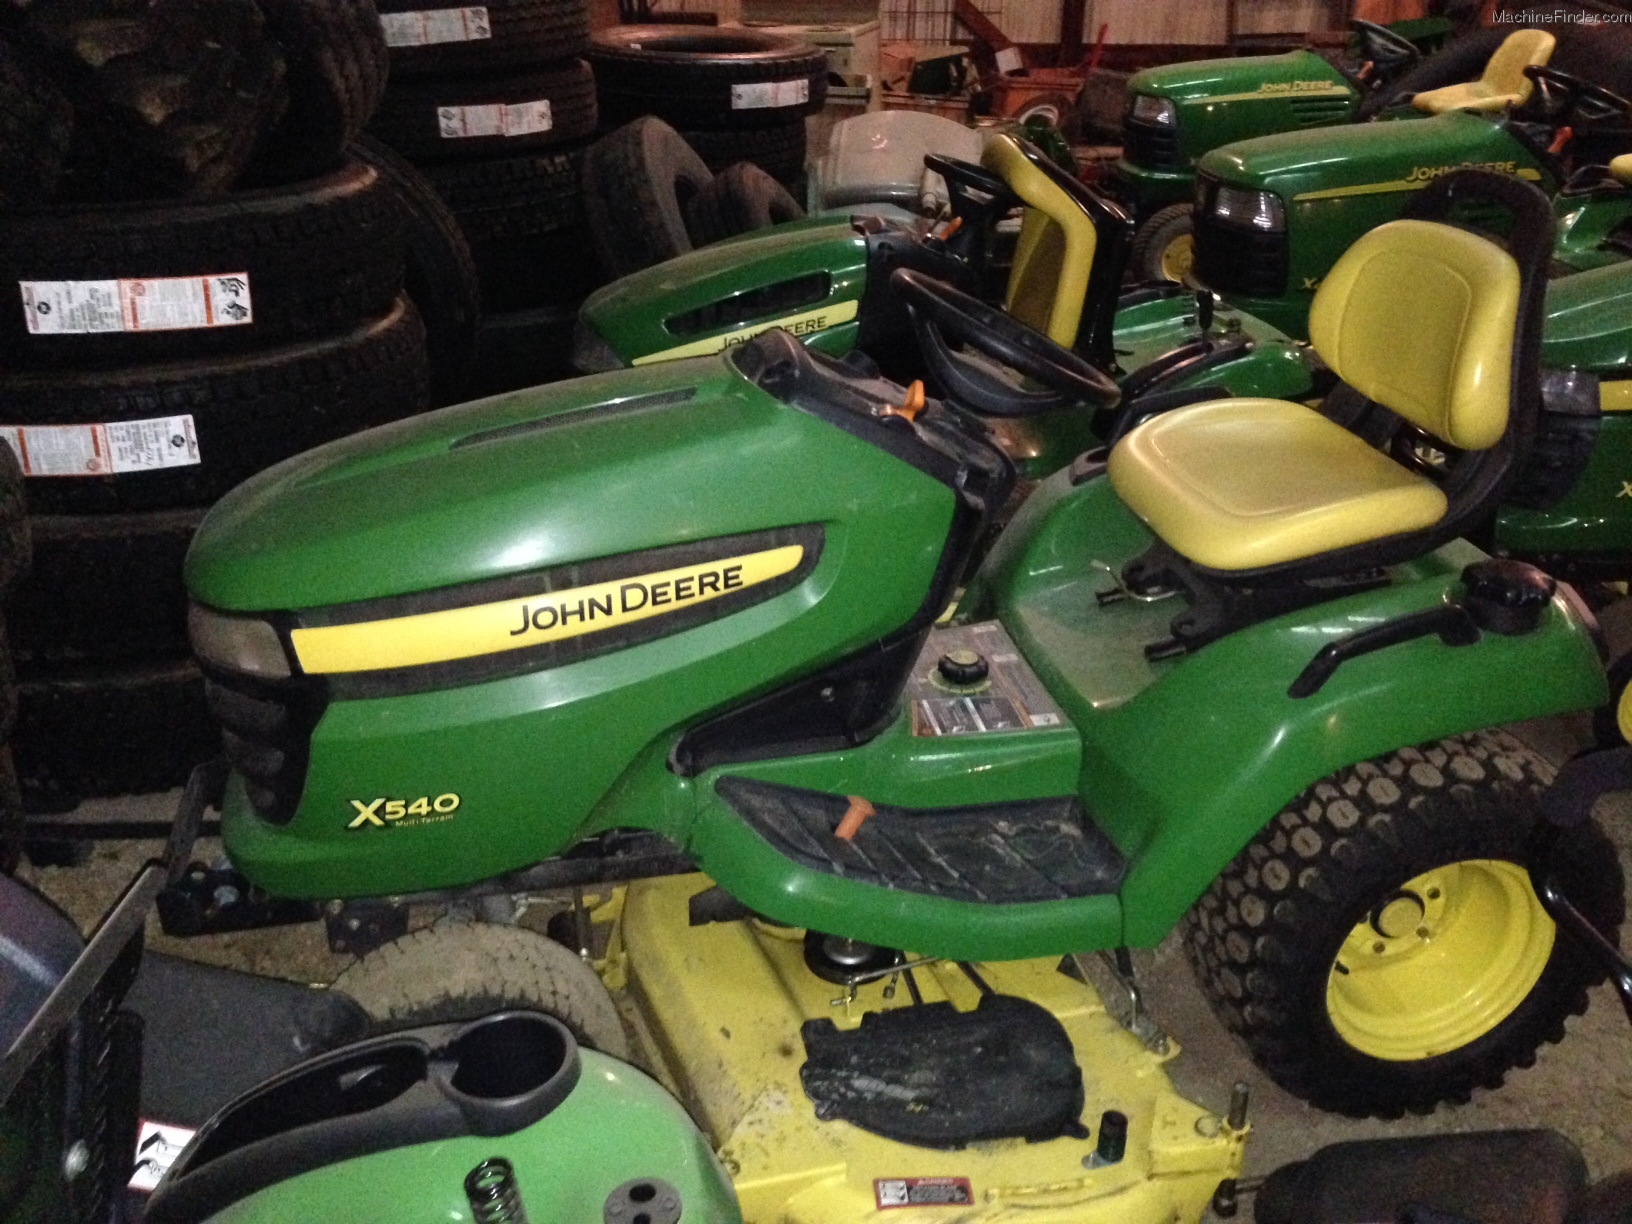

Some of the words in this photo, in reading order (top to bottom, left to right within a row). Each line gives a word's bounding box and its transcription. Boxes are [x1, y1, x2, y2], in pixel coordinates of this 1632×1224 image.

[1257, 82, 1291, 94] JOHN
[1292, 80, 1334, 91] DEERE
[510, 594, 612, 636] JOHN
[620, 564, 743, 613] DEERE
[348, 793, 460, 828] X540
